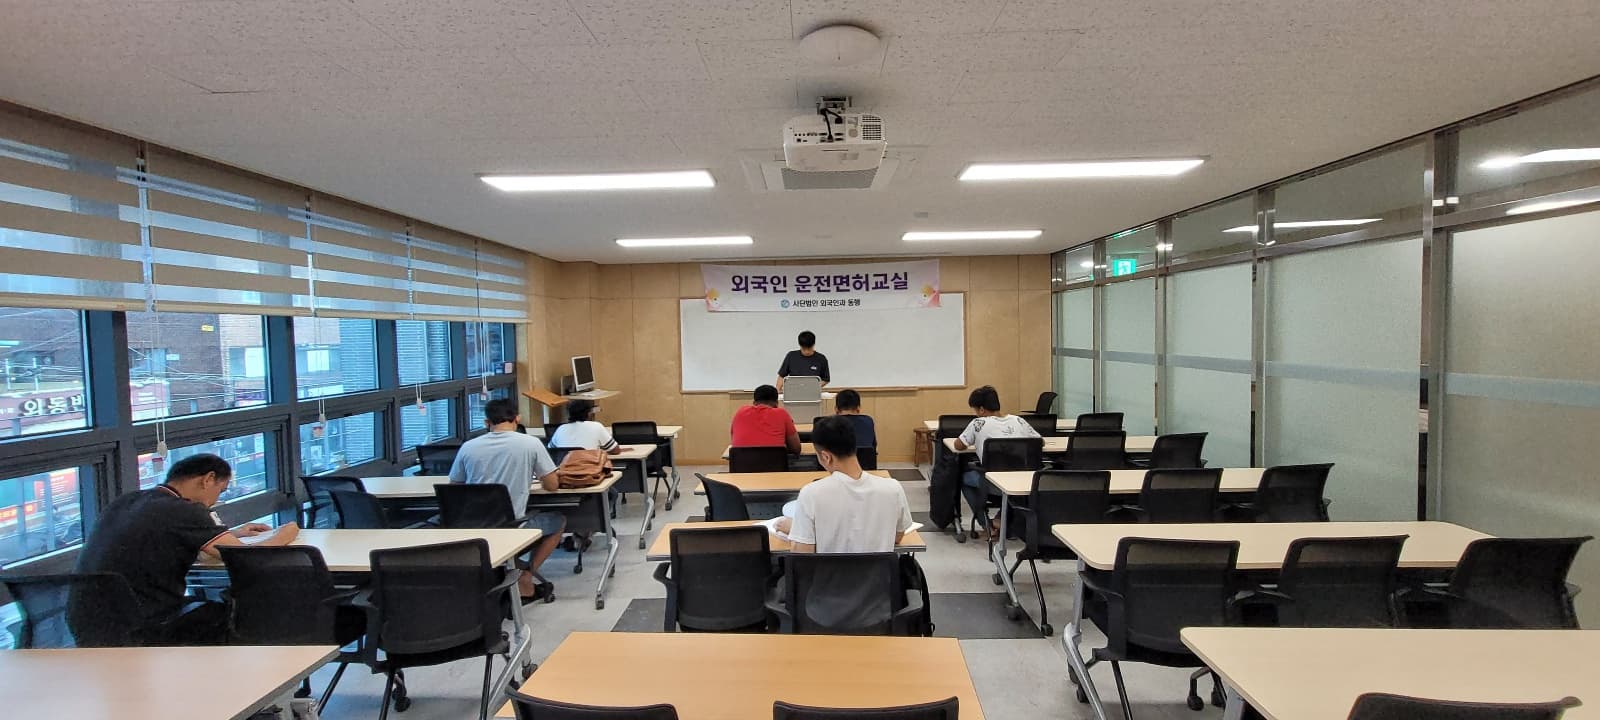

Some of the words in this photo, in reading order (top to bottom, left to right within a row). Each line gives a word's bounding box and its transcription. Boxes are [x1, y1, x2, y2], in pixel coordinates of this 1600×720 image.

[731, 275, 788, 293] 외국인
[794, 272, 908, 293] 운전면허교실
[792, 299, 818, 308] 사단법인
[820, 299, 846, 307] 외국인과
